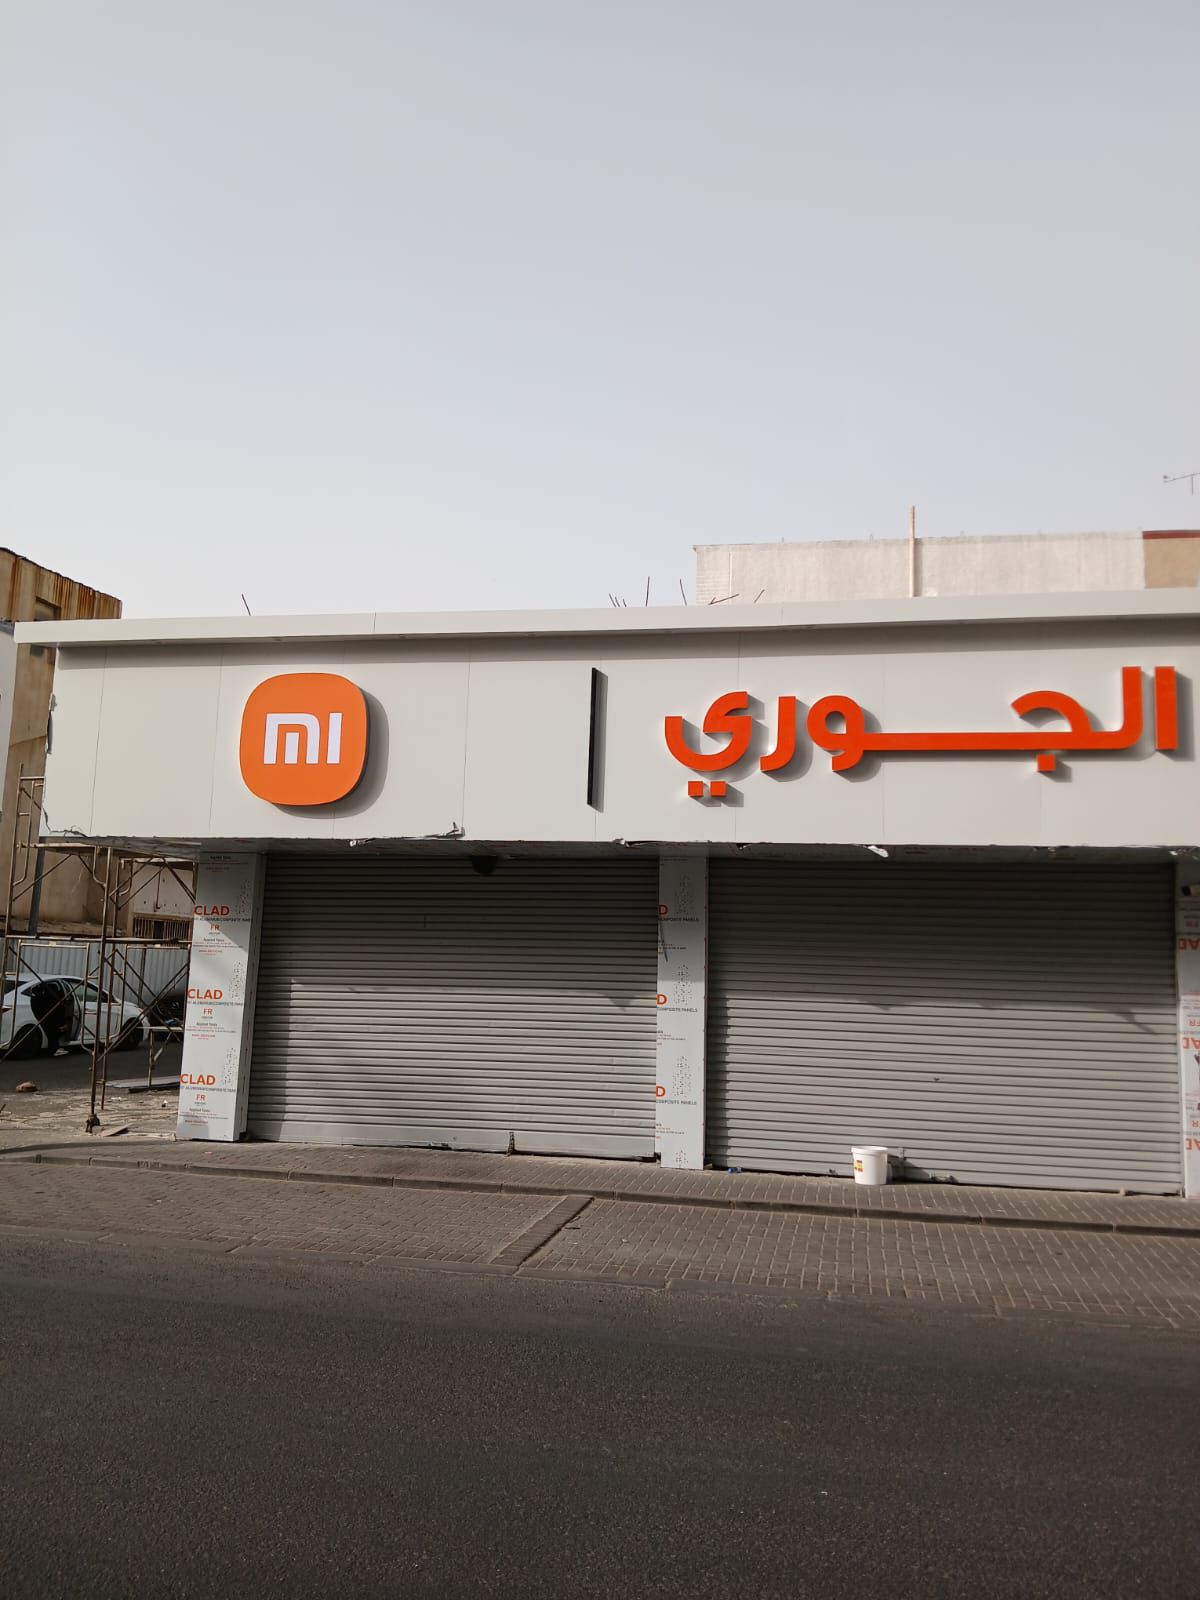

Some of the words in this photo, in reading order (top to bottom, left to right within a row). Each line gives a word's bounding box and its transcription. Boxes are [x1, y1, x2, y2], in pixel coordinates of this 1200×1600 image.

[664, 666, 1178, 797] الجوري
[194, 905, 230, 916] CLAD
[187, 988, 223, 1000] CLAD
[180, 1073, 216, 1085] CLAD
[196, 1093, 206, 1101] FR
